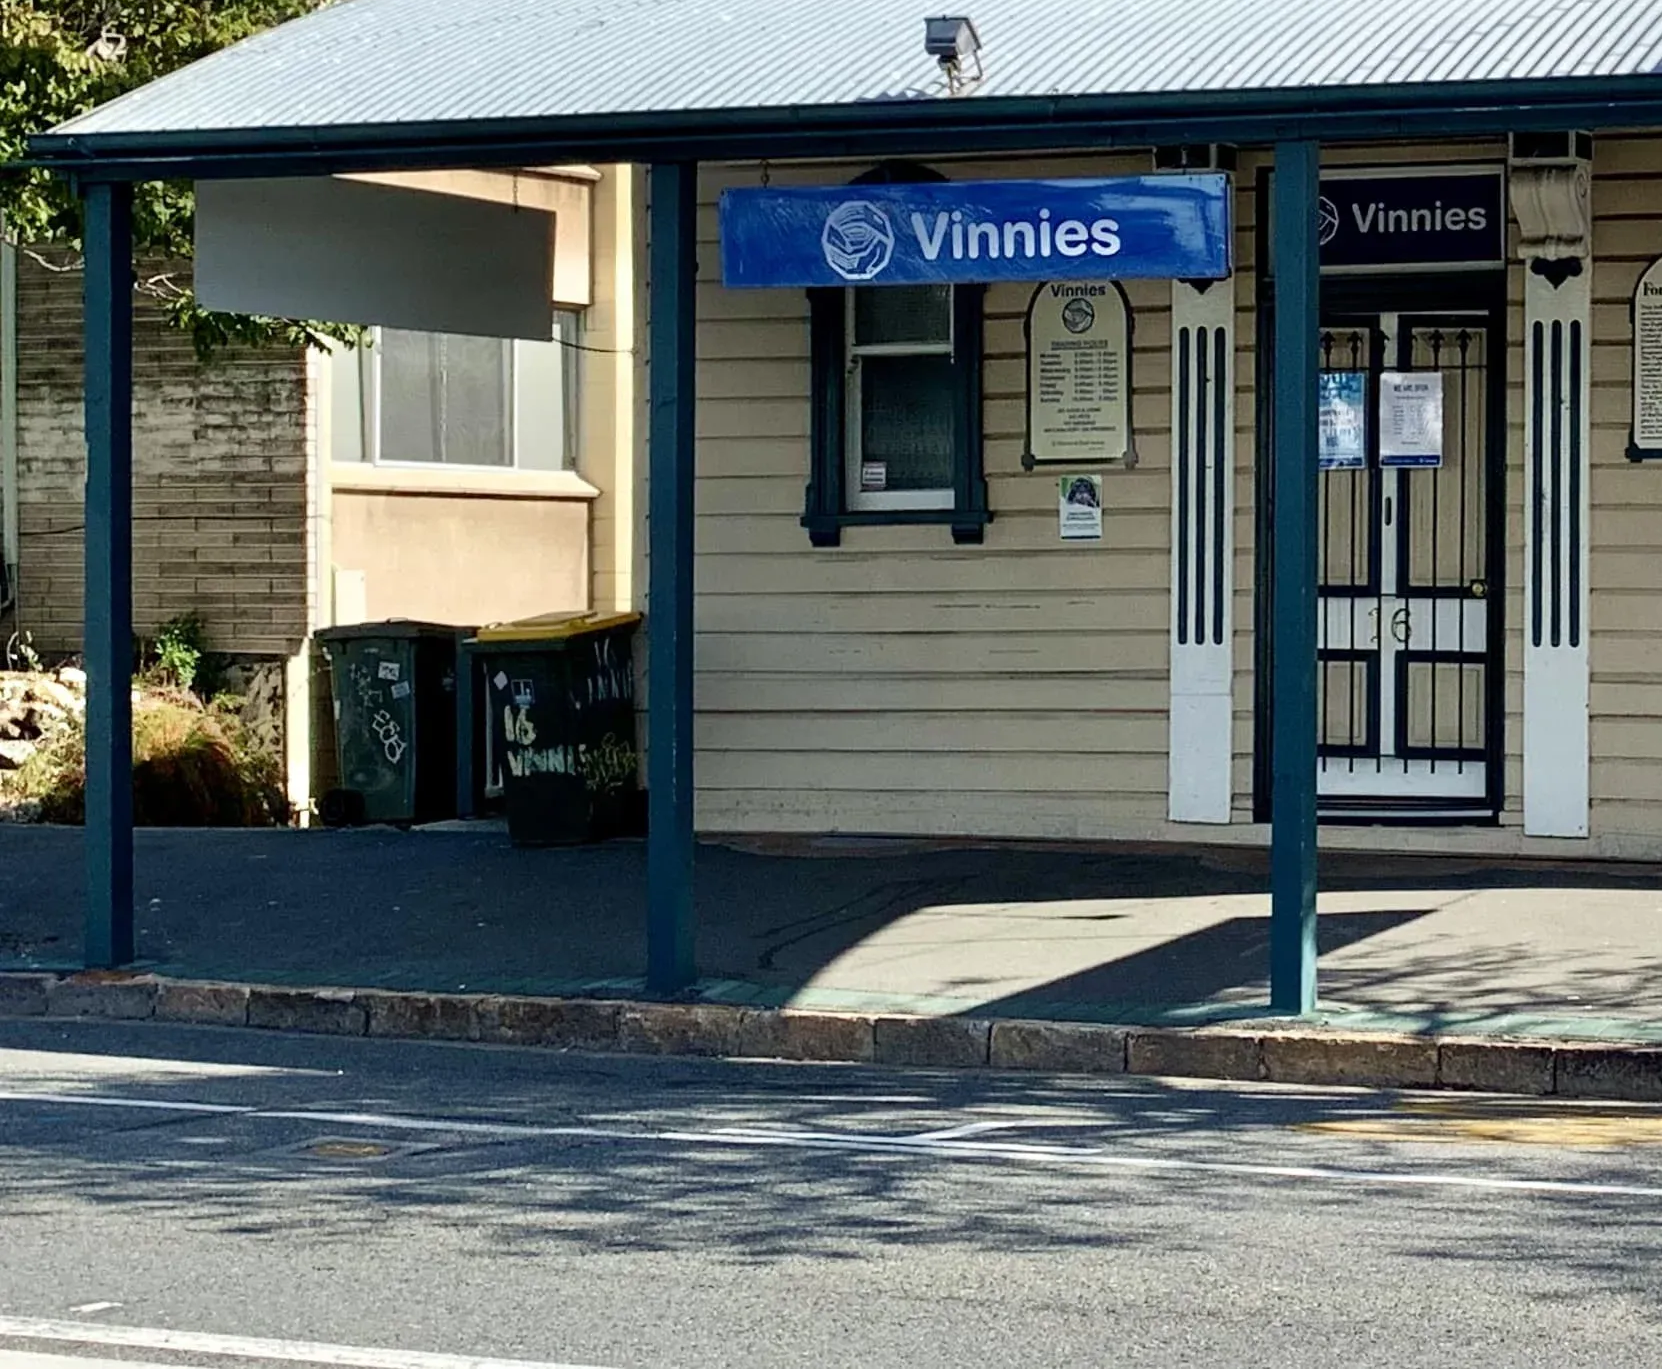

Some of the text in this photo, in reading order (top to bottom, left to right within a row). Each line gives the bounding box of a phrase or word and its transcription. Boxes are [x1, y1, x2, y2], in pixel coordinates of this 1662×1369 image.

[910, 207, 1121, 261] Vinnies
[1351, 200, 1488, 234] Vinnies
[1051, 283, 1107, 298] Vinnies
